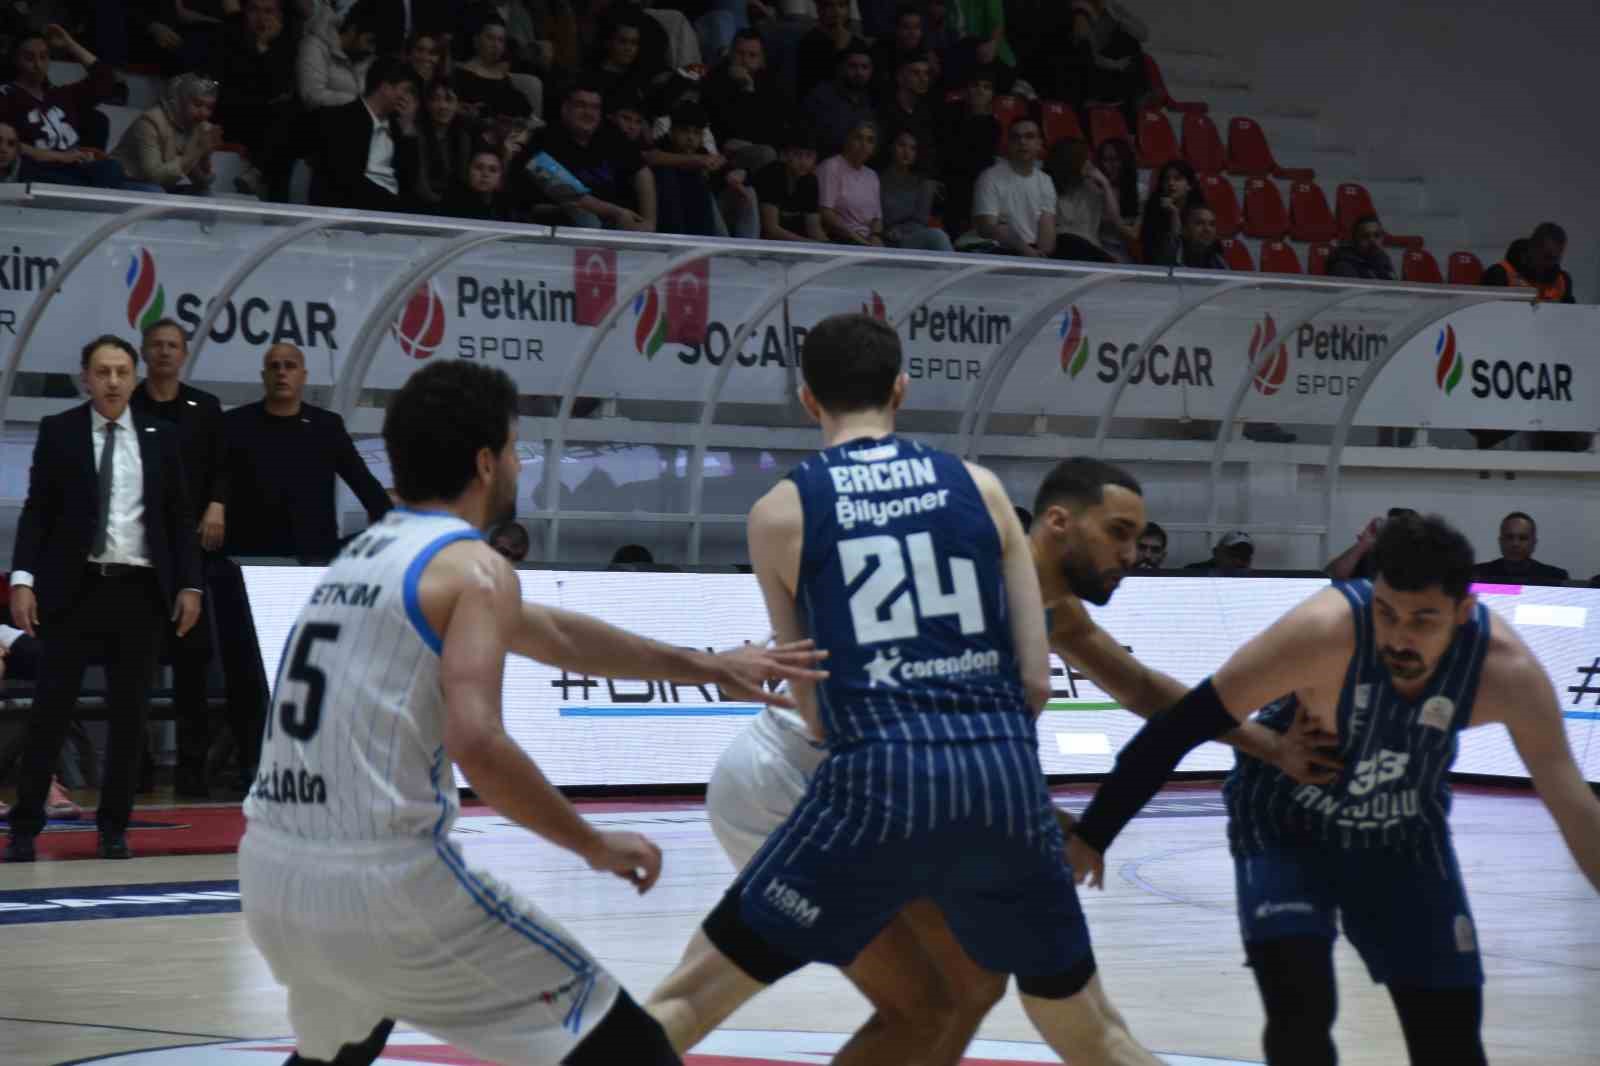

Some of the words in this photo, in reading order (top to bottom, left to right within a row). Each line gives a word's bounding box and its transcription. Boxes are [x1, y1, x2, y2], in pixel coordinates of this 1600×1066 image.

[457, 276, 577, 323] Petkim
[176, 293, 338, 350] SOCAR
[909, 304, 1010, 344] Petkim
[458, 336, 544, 361] SPOR
[1297, 323, 1389, 361] Petkim
[909, 358, 982, 381] SPOR
[1096, 342, 1215, 386] SOCAR
[1471, 359, 1573, 401] SOCAR
[828, 457, 937, 493] ERCAN
[835, 489, 949, 529] Bilyoner
[836, 531, 986, 645] 24
[901, 649, 999, 679] corendon
[1348, 749, 1410, 795] 33
[1294, 784, 1419, 818] ANDOLU
